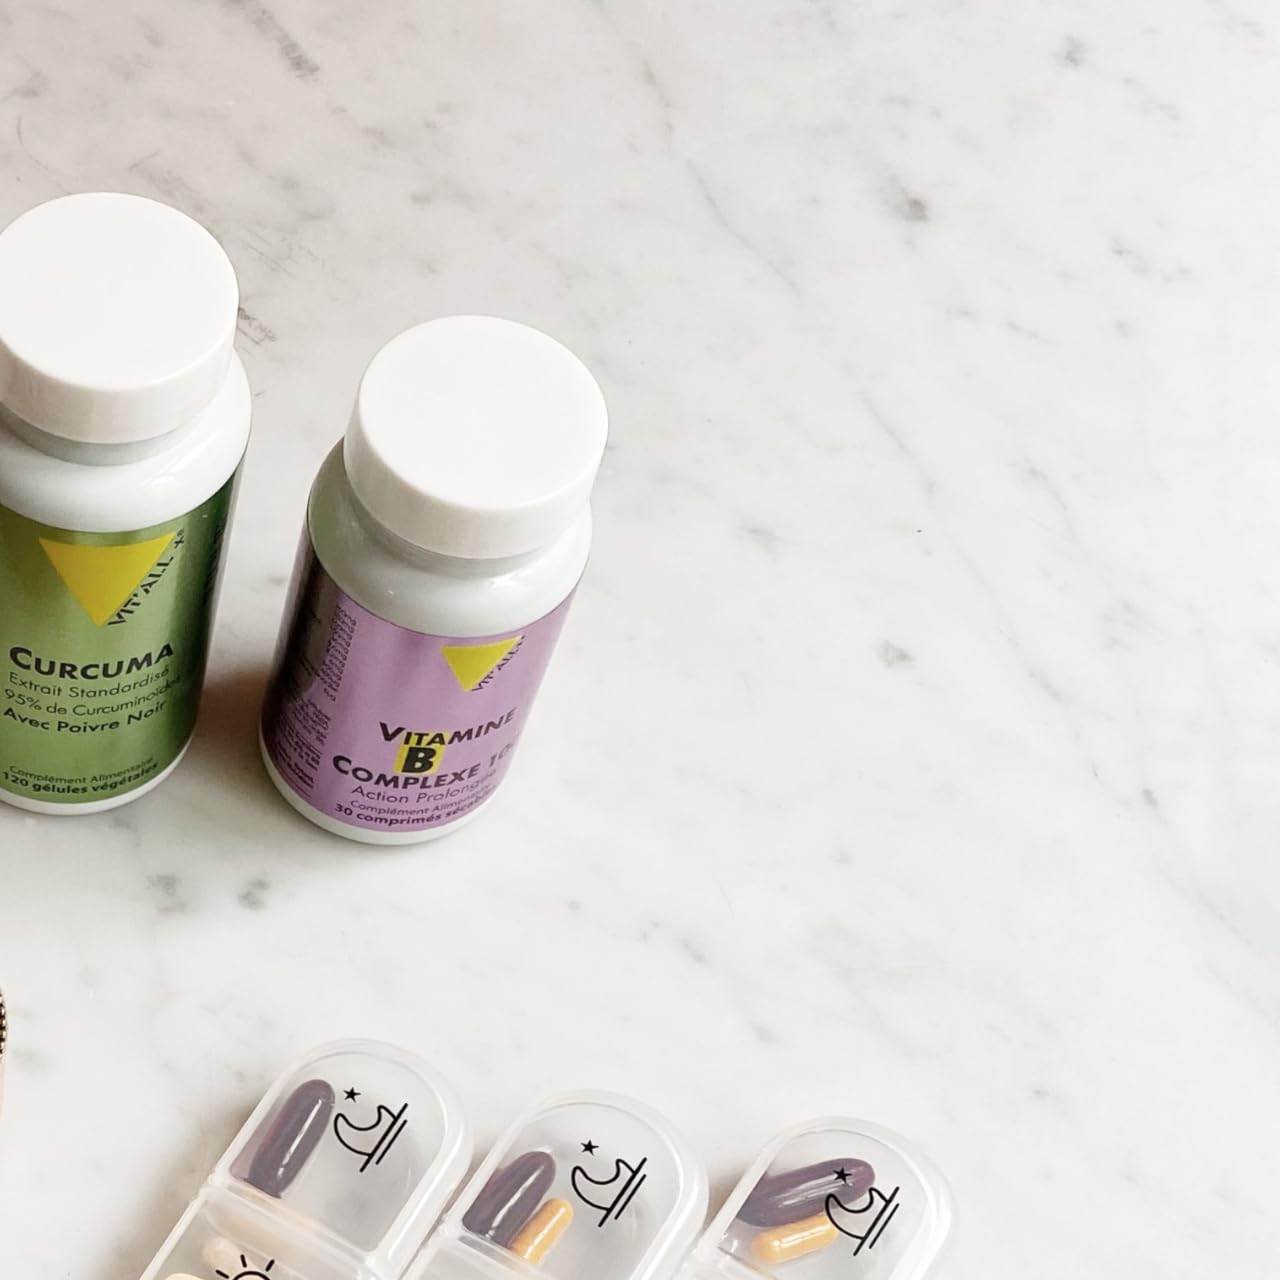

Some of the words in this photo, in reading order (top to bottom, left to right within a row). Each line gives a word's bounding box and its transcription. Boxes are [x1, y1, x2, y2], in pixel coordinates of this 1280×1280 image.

[9, 643, 174, 680] CURCUMA
[8, 671, 62, 698] Extrait
[69, 664, 170, 699] Standardisé
[3, 706, 50, 732] Avec
[56, 718, 121, 734] Poivre
[127, 700, 168, 726] Noir
[4, 690, 42, 711] 95%
[46, 701, 68, 716] de
[379, 707, 518, 746] VITAMINE
[9, 765, 87, 785] Complément
[332, 755, 481, 790] COMPLEXE
[401, 746, 437, 774] B
[2, 771, 29, 788] 120
[32, 782, 88, 795] gélules
[91, 762, 158, 793] végétales
[351, 785, 410, 804] Action
[351, 800, 429, 816] Complément
[335, 803, 353, 817] 30
[357, 812, 442, 827] comprimés
